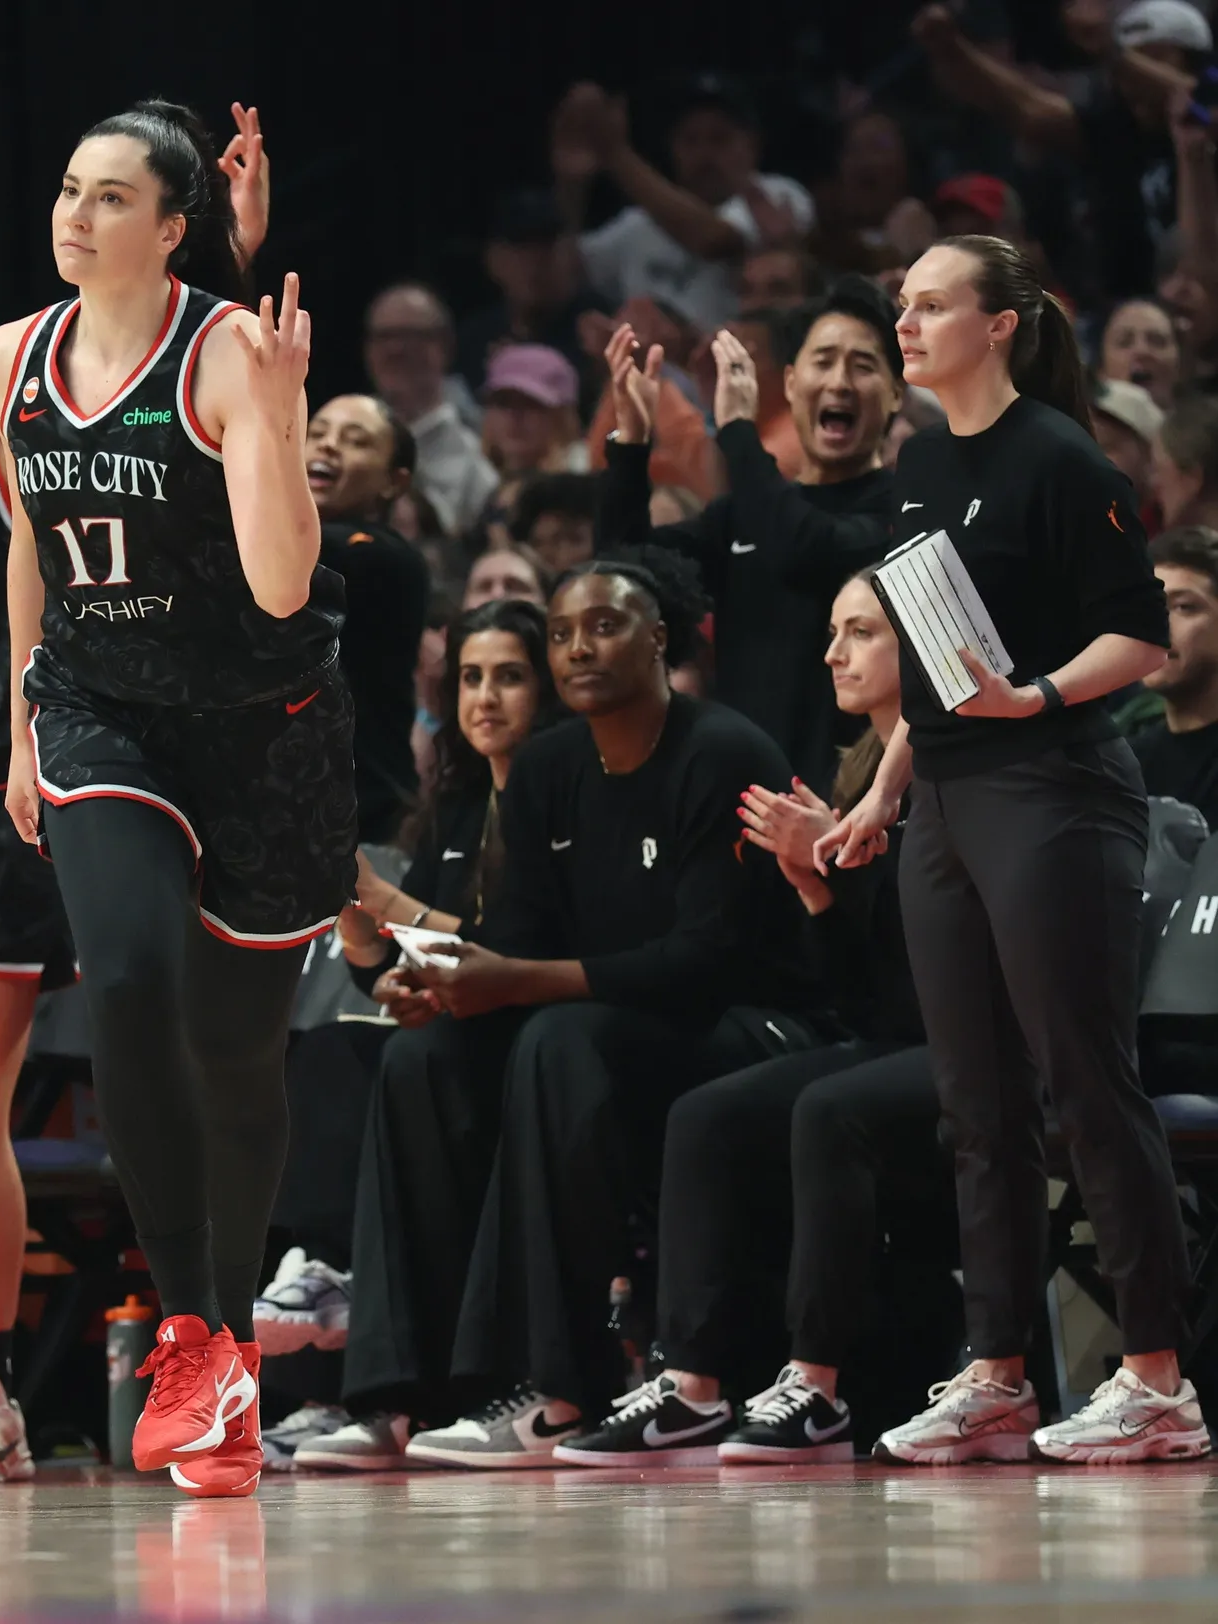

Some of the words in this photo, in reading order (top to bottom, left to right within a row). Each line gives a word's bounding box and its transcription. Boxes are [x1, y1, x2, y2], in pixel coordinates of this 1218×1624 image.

[123, 407, 172, 426] chime
[17, 451, 81, 495] ROSE
[91, 452, 168, 501] CITY
[51, 517, 132, 587] 17
